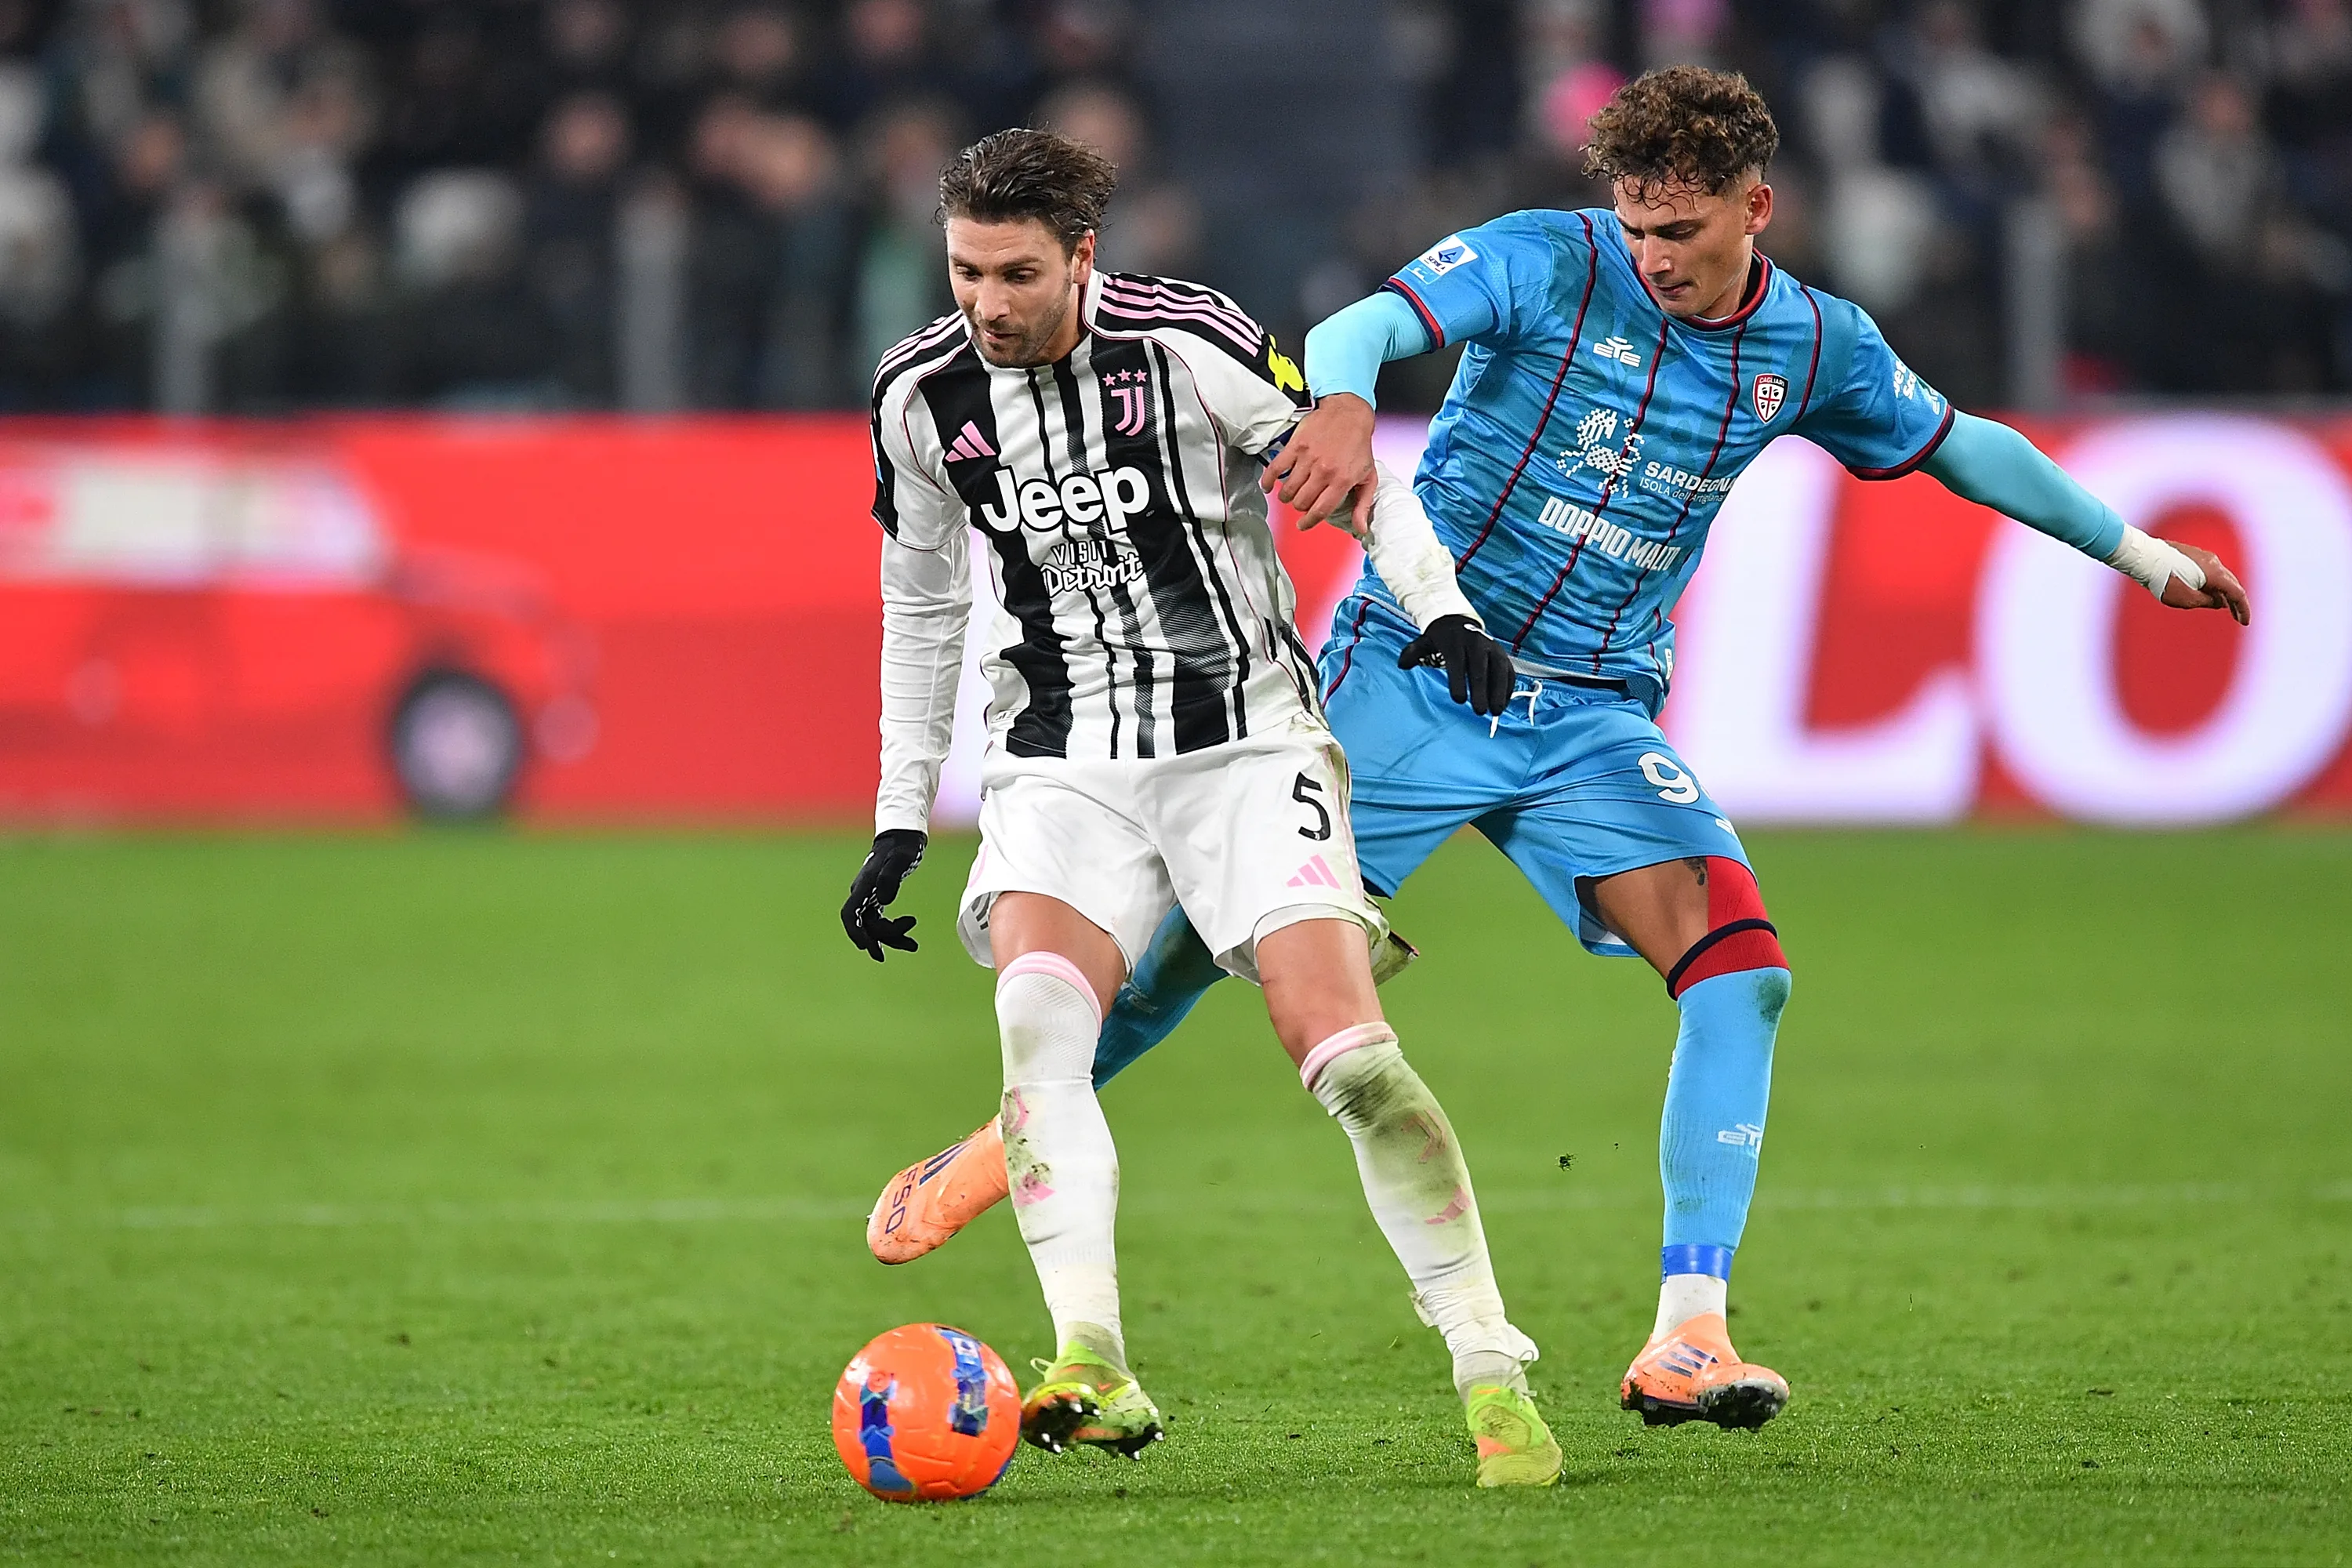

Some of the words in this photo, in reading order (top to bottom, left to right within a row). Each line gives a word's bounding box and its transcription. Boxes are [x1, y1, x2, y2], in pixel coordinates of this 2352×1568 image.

[1759, 376, 1785, 387] CAGLIARI
[980, 466, 1150, 532] Jeep
[1639, 477, 1671, 495] ISOLA
[1051, 539, 1108, 565] VISIT
[1537, 495, 1632, 559] DOPPIO
[1623, 537, 1682, 571] MALTO
[1040, 552, 1144, 597] Detroit
[1637, 751, 1711, 804] 9
[1292, 771, 1331, 841] 5
